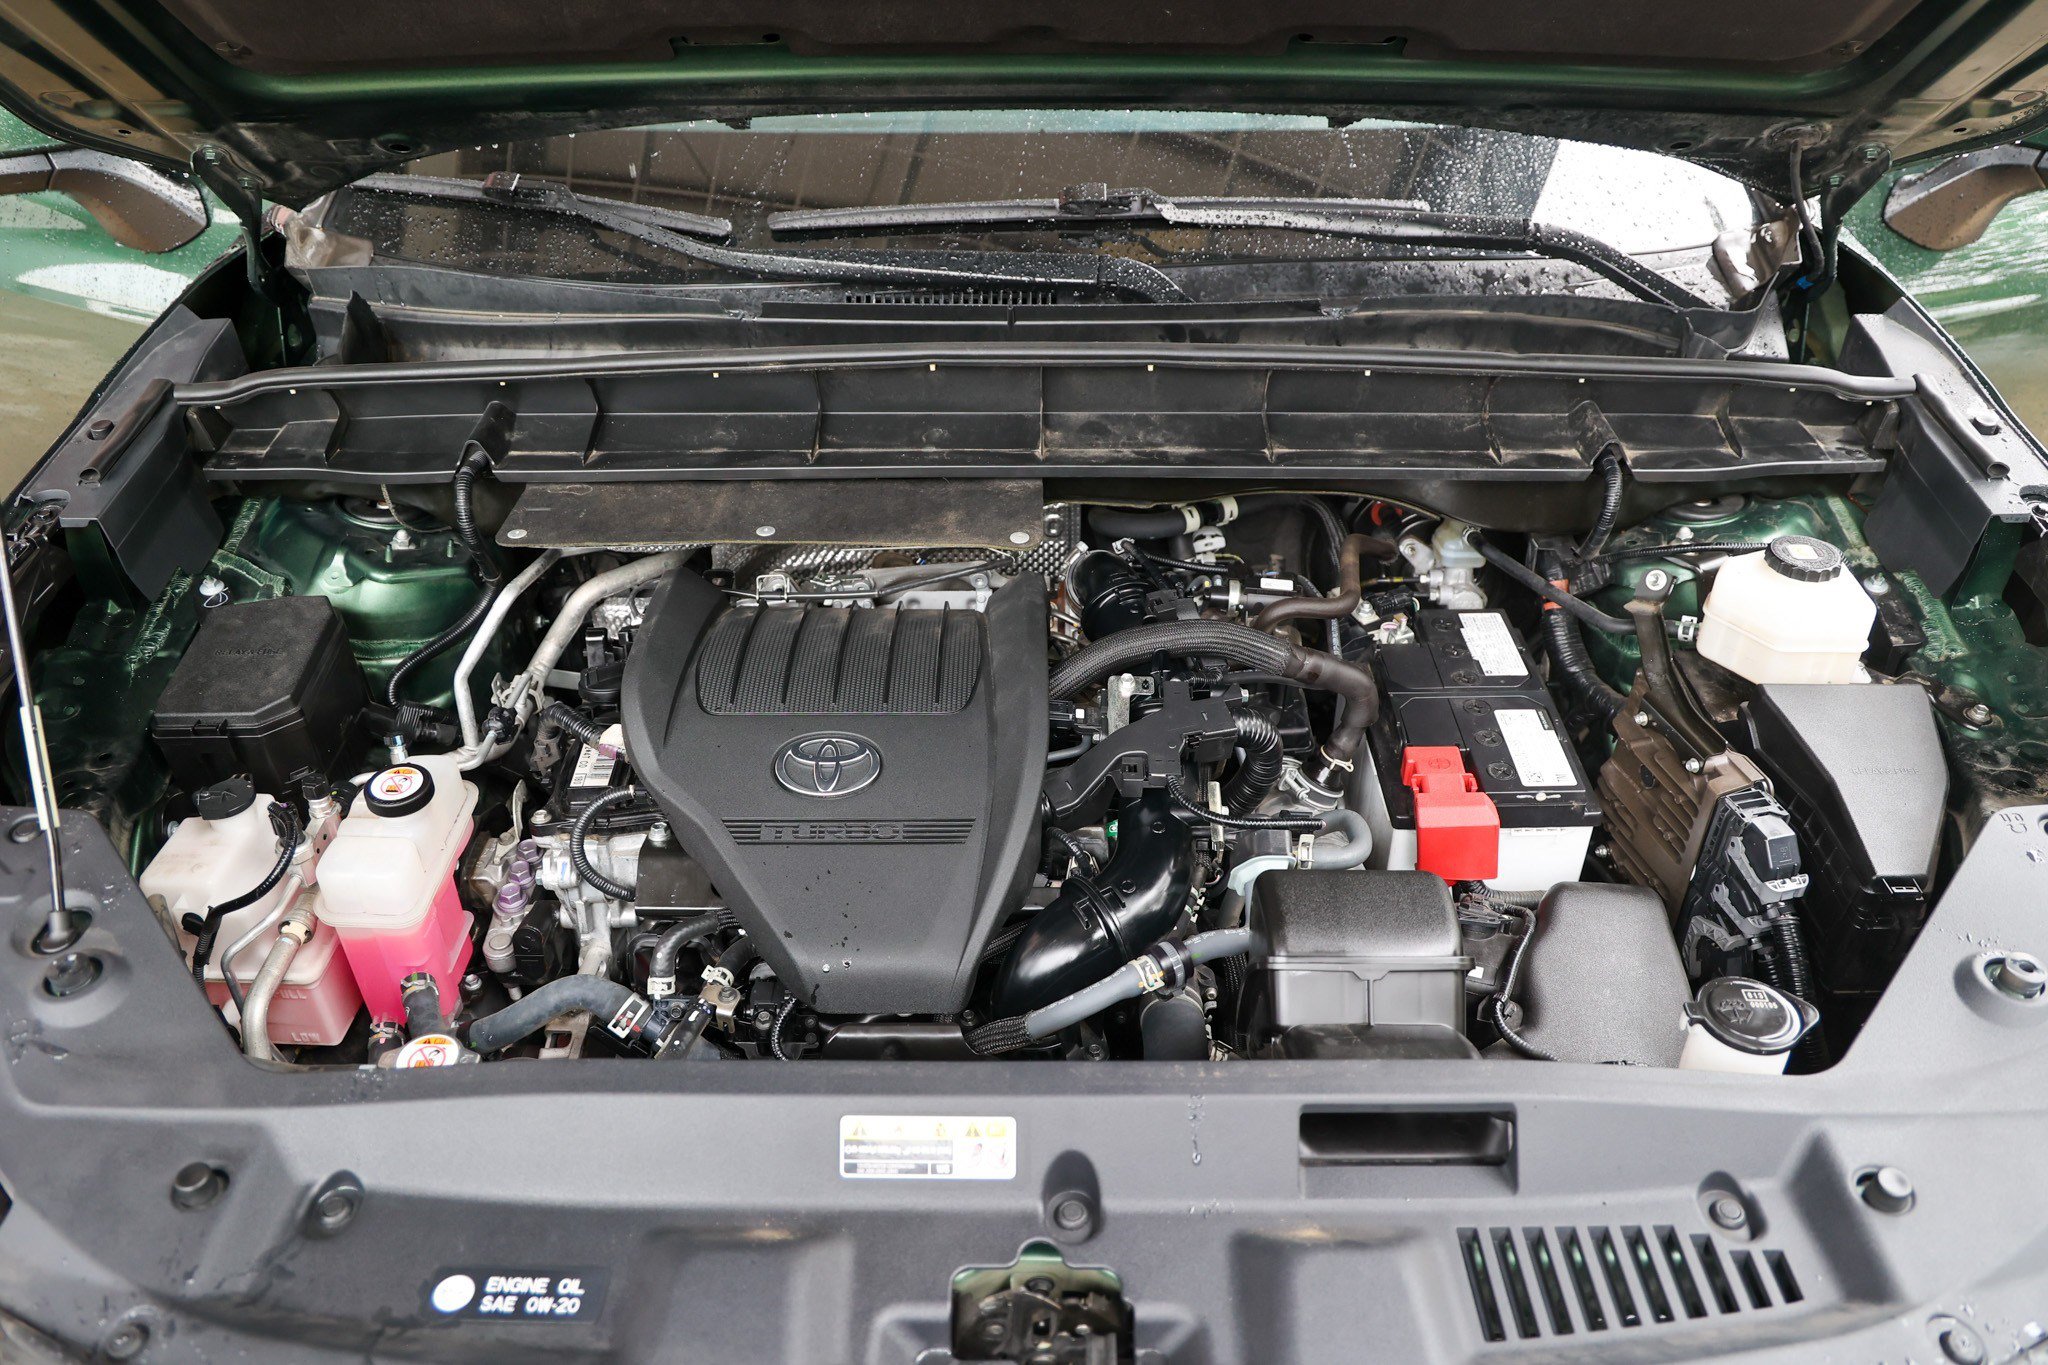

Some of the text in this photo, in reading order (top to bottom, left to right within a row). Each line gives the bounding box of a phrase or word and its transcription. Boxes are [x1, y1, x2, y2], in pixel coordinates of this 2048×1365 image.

[761, 822, 901, 841] TURBO
[290, 1032, 321, 1043] LOW
[485, 1276, 586, 1295] ENGINE OIL
[479, 1295, 582, 1314] SAE 0W-20
